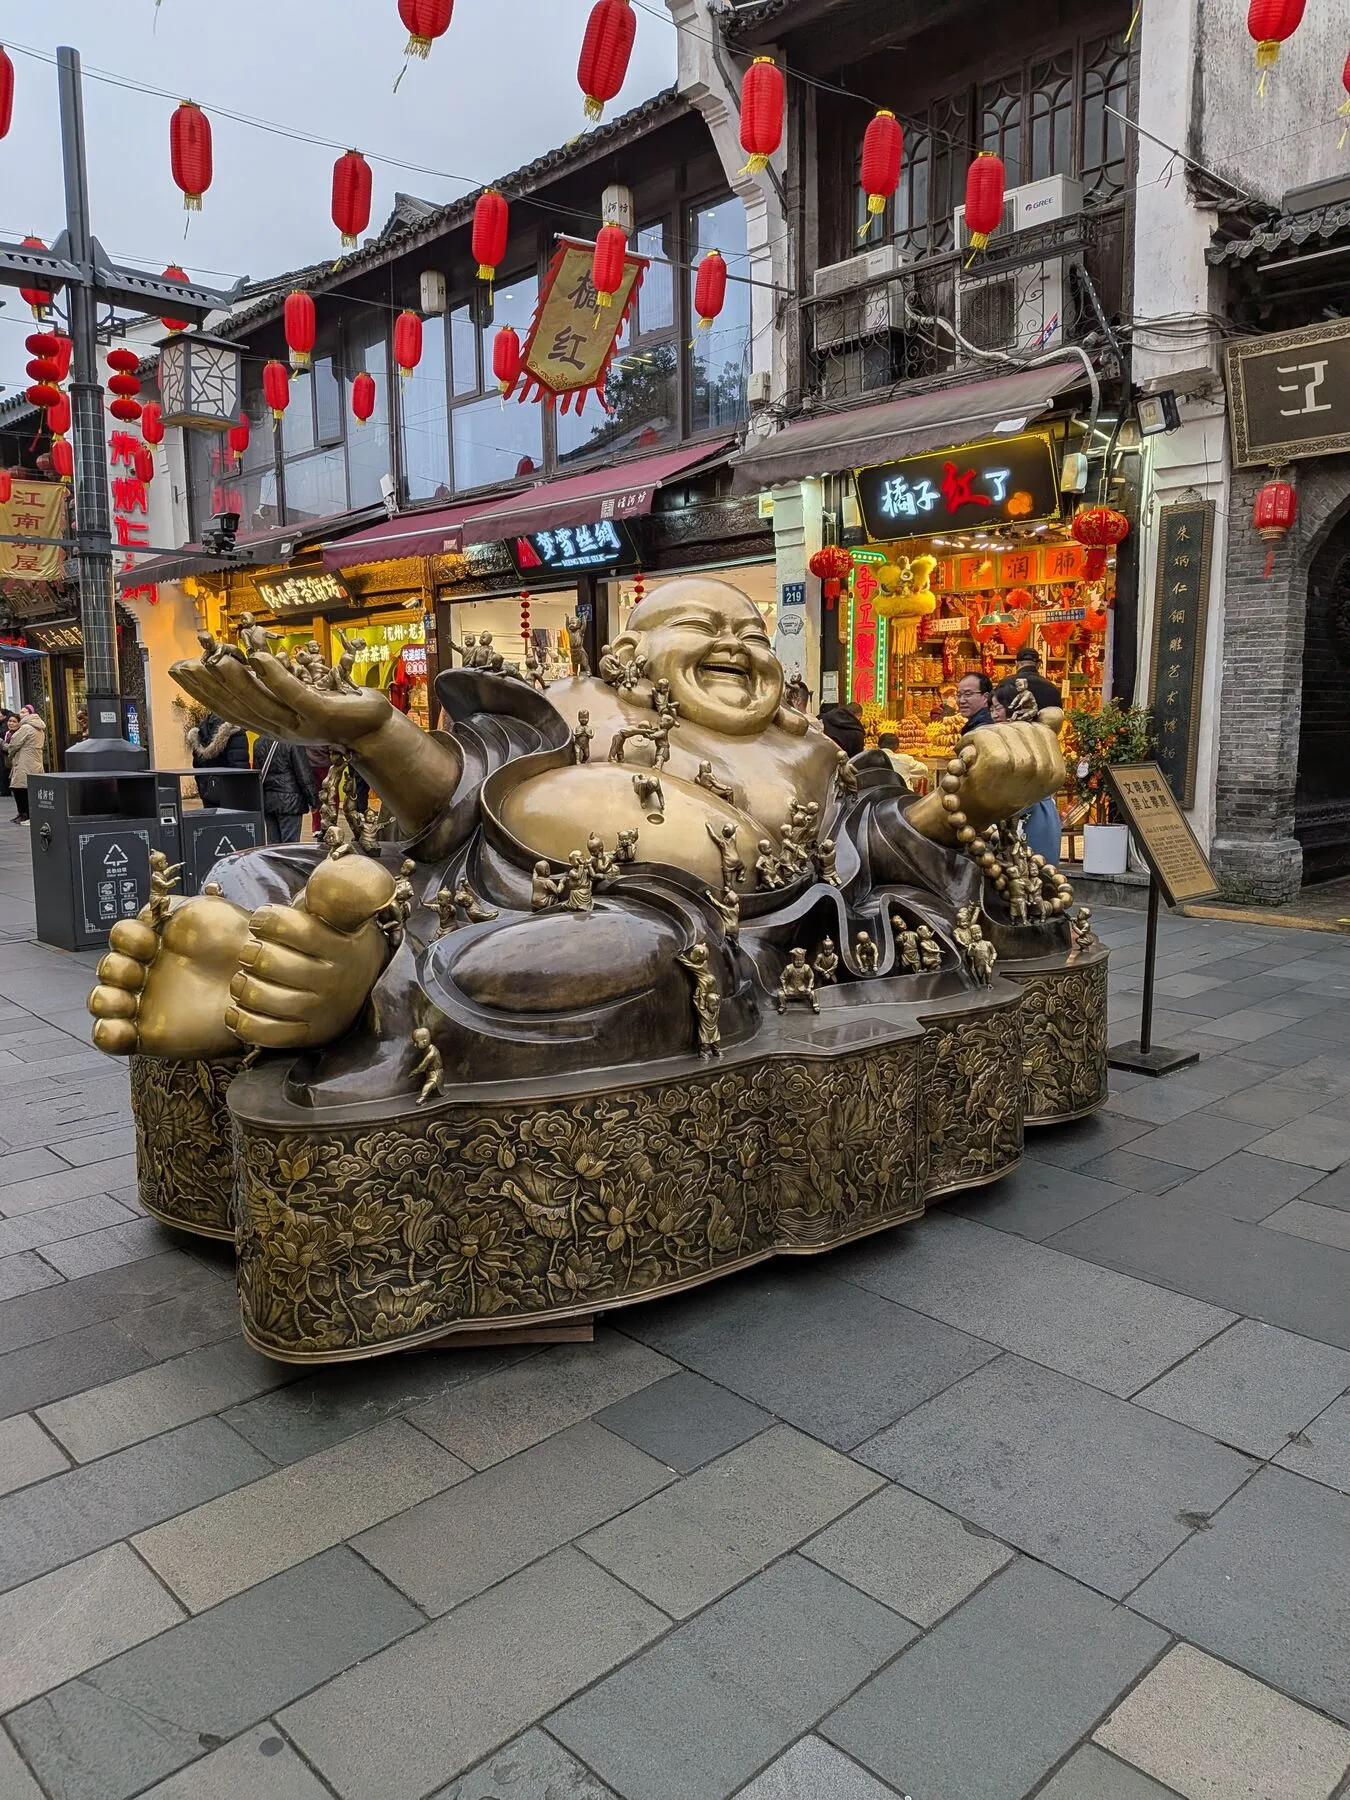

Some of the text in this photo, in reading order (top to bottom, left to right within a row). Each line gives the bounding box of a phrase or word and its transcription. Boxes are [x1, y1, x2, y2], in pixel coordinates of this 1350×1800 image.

[1033, 196, 1054, 209] GREE
[881, 460, 1011, 518] 橘子红了
[786, 591, 801, 603] 219
[127, 714, 139, 724] TAX
[128, 723, 140, 733] FREE
[1123, 779, 1162, 795] 文明参观
[1131, 794, 1170, 811] 禁止攀爬
